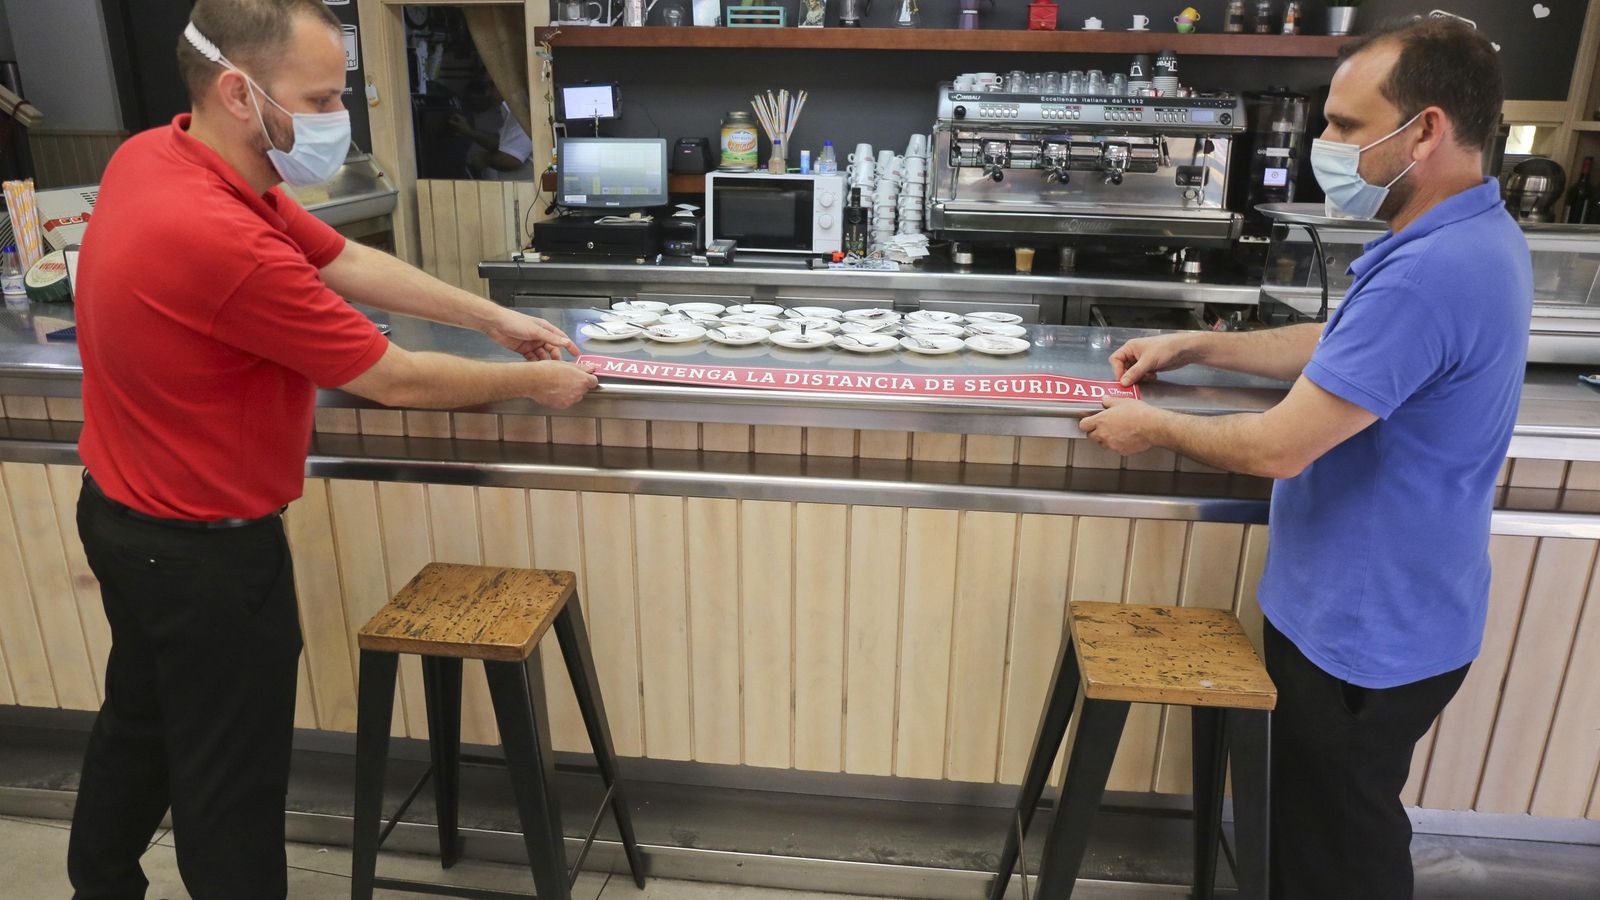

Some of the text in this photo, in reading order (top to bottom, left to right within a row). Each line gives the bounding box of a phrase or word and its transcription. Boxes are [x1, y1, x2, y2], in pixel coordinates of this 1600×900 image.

[603, 360, 737, 381] MANTENGA
[745, 371, 776, 383] LA
[784, 372, 916, 390] DISTANCIA
[924, 378, 955, 392] DE
[964, 379, 1106, 398] SEGURIDAD
